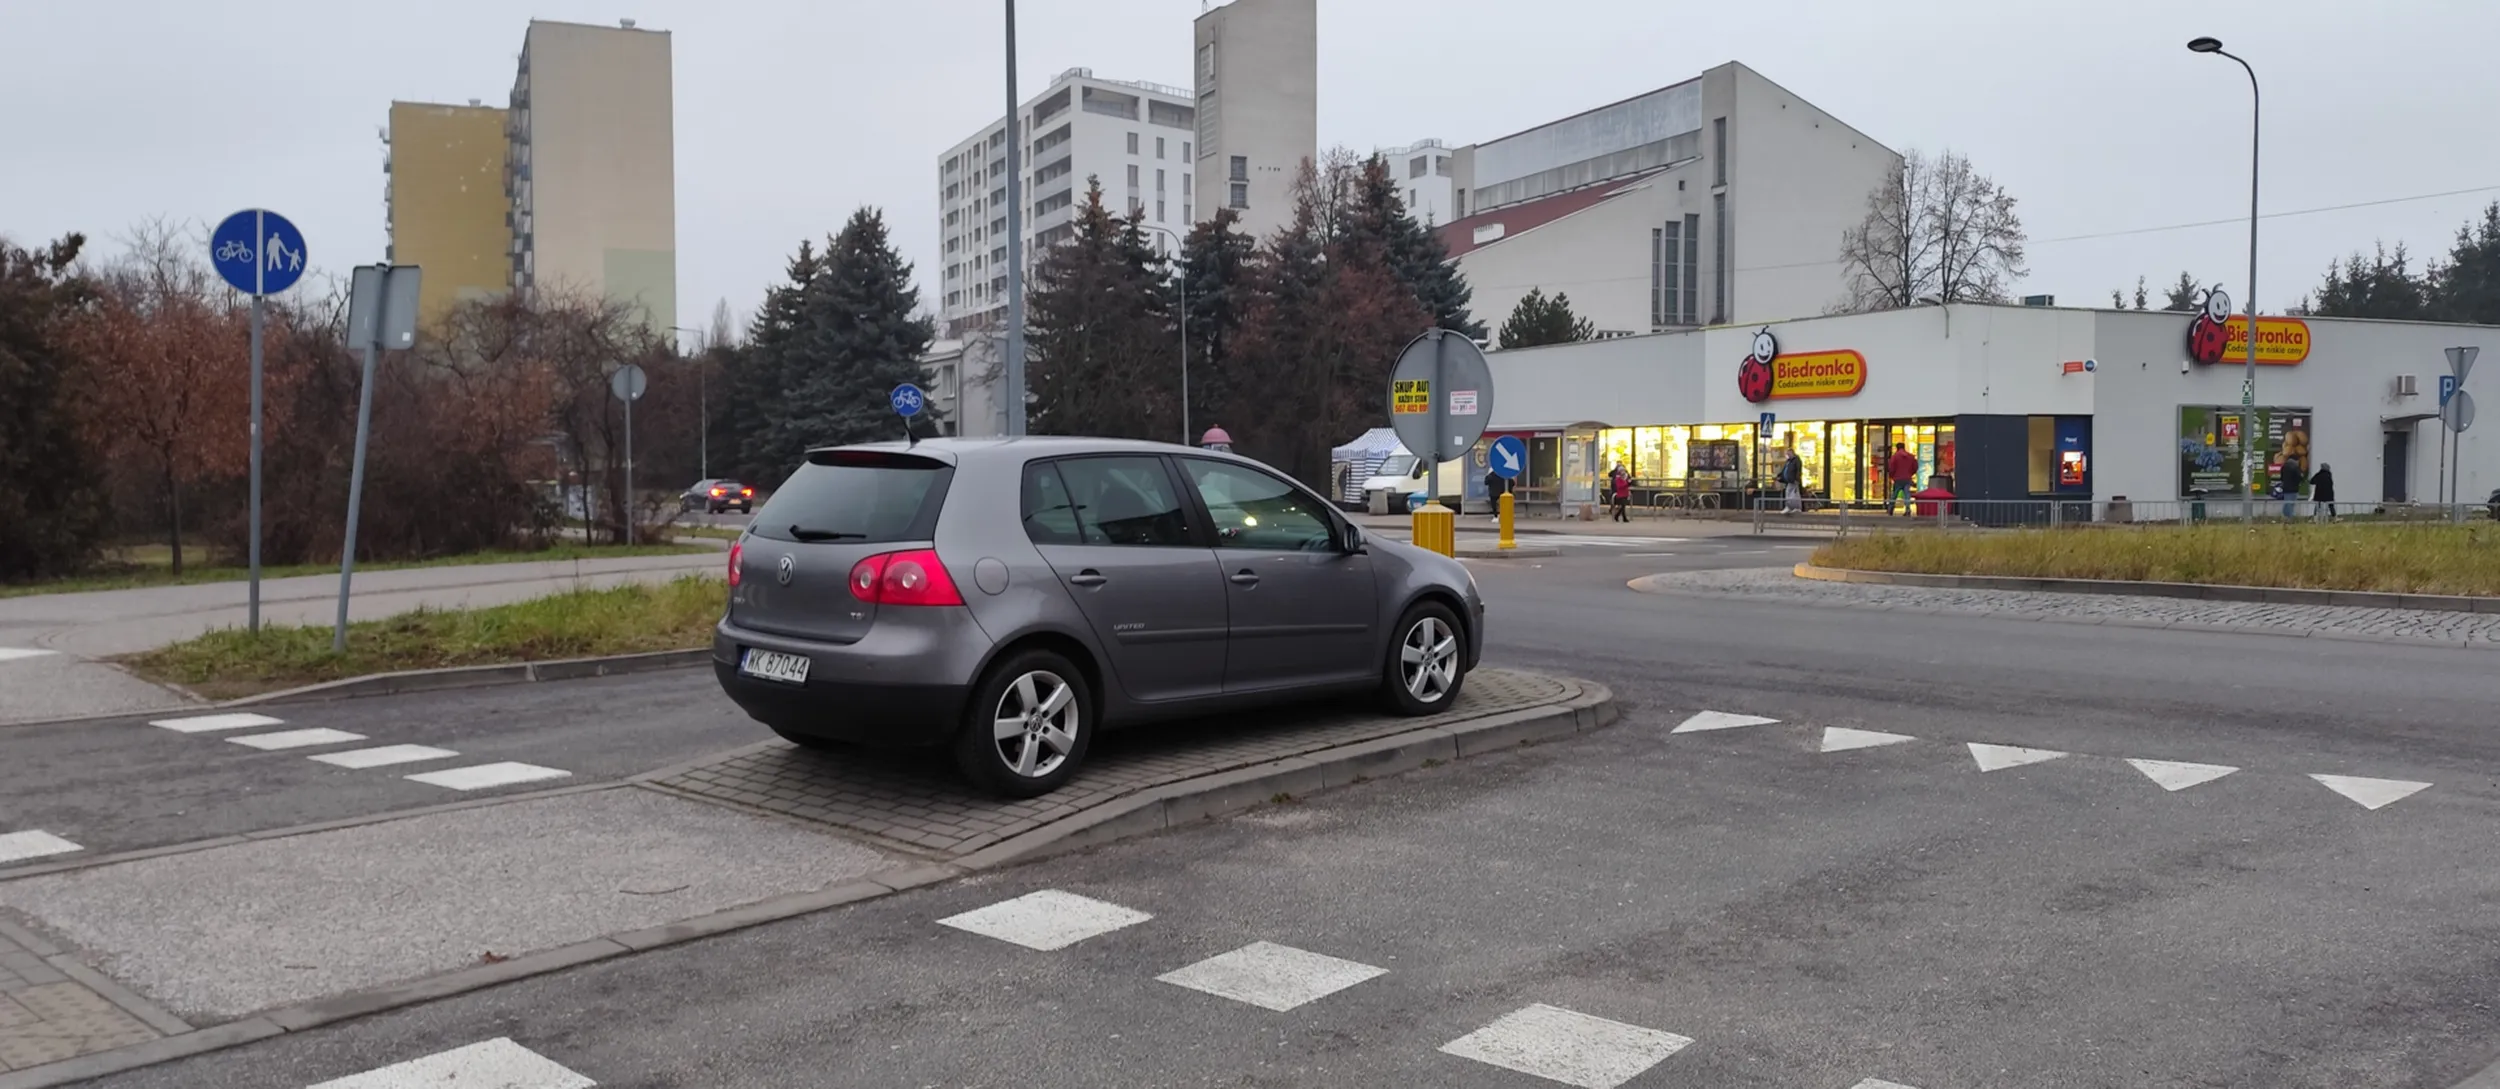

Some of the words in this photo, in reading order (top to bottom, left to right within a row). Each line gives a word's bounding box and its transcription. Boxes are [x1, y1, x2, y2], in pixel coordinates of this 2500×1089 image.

[1778, 360, 1854, 378] Biedronka
[1395, 381, 1414, 393] SKUP
[1777, 379, 1814, 388] Codziennie
[1816, 378, 1835, 386] niskie
[1837, 378, 1854, 387] ceny
[2443, 379, 2453, 396] P
[1113, 622, 1145, 630] UNITED
[748, 648, 765, 671] WK
[765, 653, 807, 680] 87044
